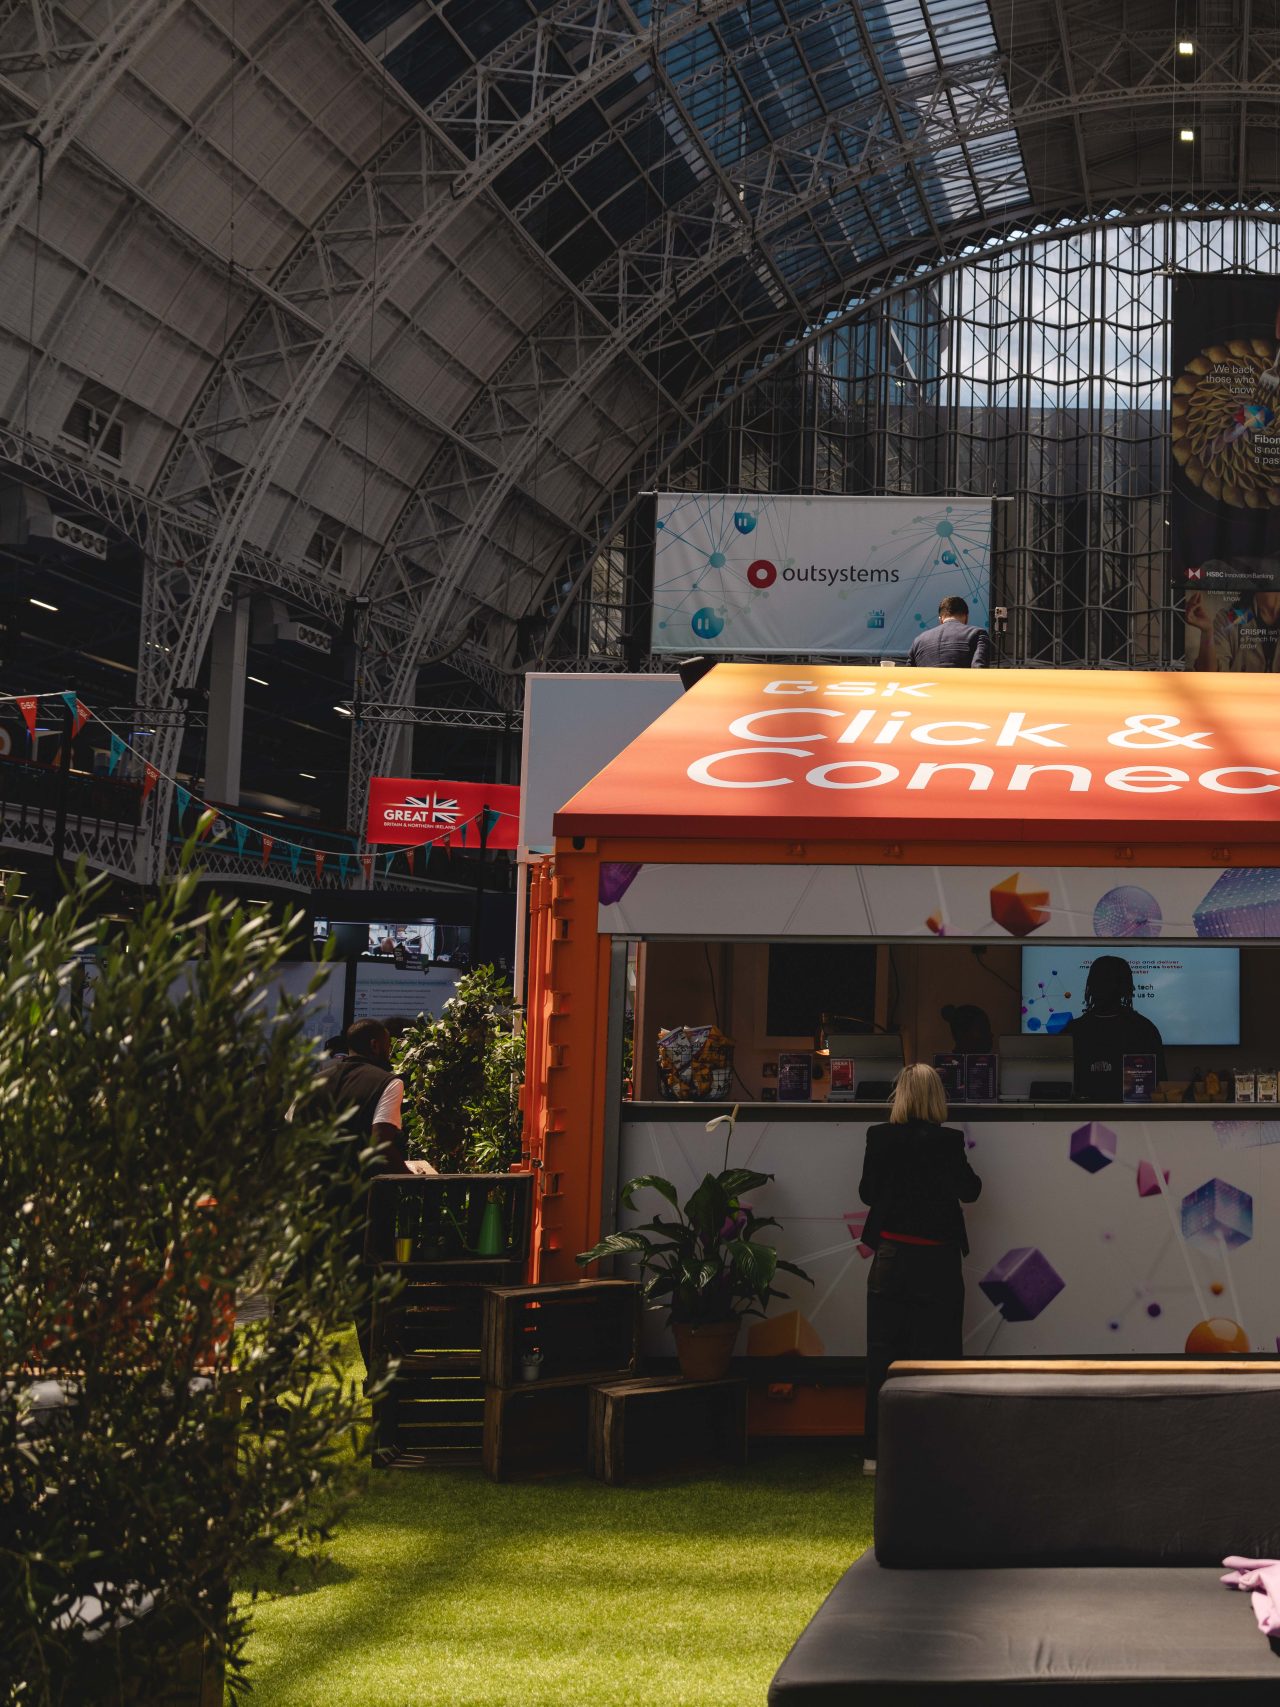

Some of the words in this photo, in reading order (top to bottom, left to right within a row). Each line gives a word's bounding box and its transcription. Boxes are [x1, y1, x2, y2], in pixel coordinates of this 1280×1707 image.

[1214, 364, 1229, 373] We
[1232, 365, 1255, 374] back
[1206, 375, 1231, 384] those
[1234, 375, 1255, 384] who
[1229, 385, 1255, 394] know
[1254, 445, 1262, 454] is
[1264, 445, 1280, 454] not
[782, 563, 900, 587] outsystems
[1252, 573, 1274, 581] Banking
[1240, 628, 1267, 636] CRISPR
[762, 680, 940, 699] GSK
[728, 707, 1072, 748] Click
[1106, 713, 1215, 750] &
[384, 809, 428, 822] GREAT
